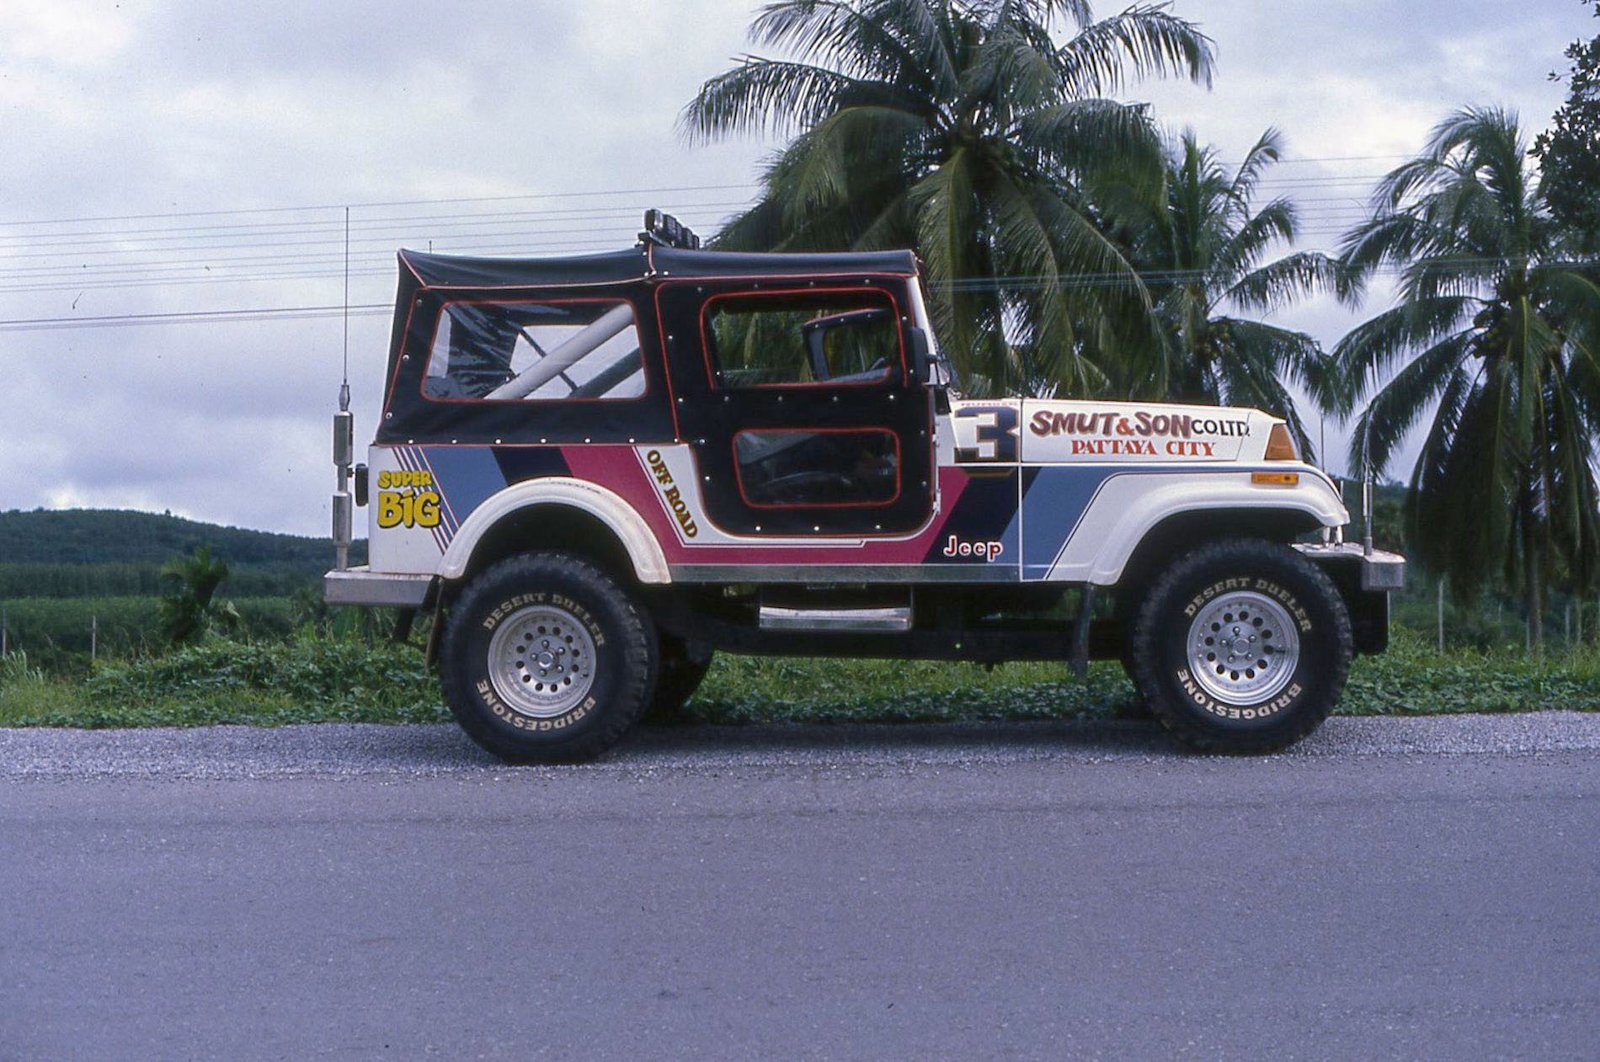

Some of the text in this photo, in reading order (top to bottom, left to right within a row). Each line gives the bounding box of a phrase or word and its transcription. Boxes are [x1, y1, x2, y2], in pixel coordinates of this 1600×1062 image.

[954, 405, 1020, 478] 3
[1071, 439, 1216, 457] PATTAYA CITY
[377, 470, 432, 490] SUPER
[646, 449, 698, 539] OFF ROAD
[943, 534, 1003, 562] Jeep
[483, 592, 605, 646] DESERT DUELER
[1184, 577, 1312, 632] DESERT DUELER
[476, 679, 597, 731] BRIDGESTONE
[1177, 668, 1302, 719] BRIDGESTONE
